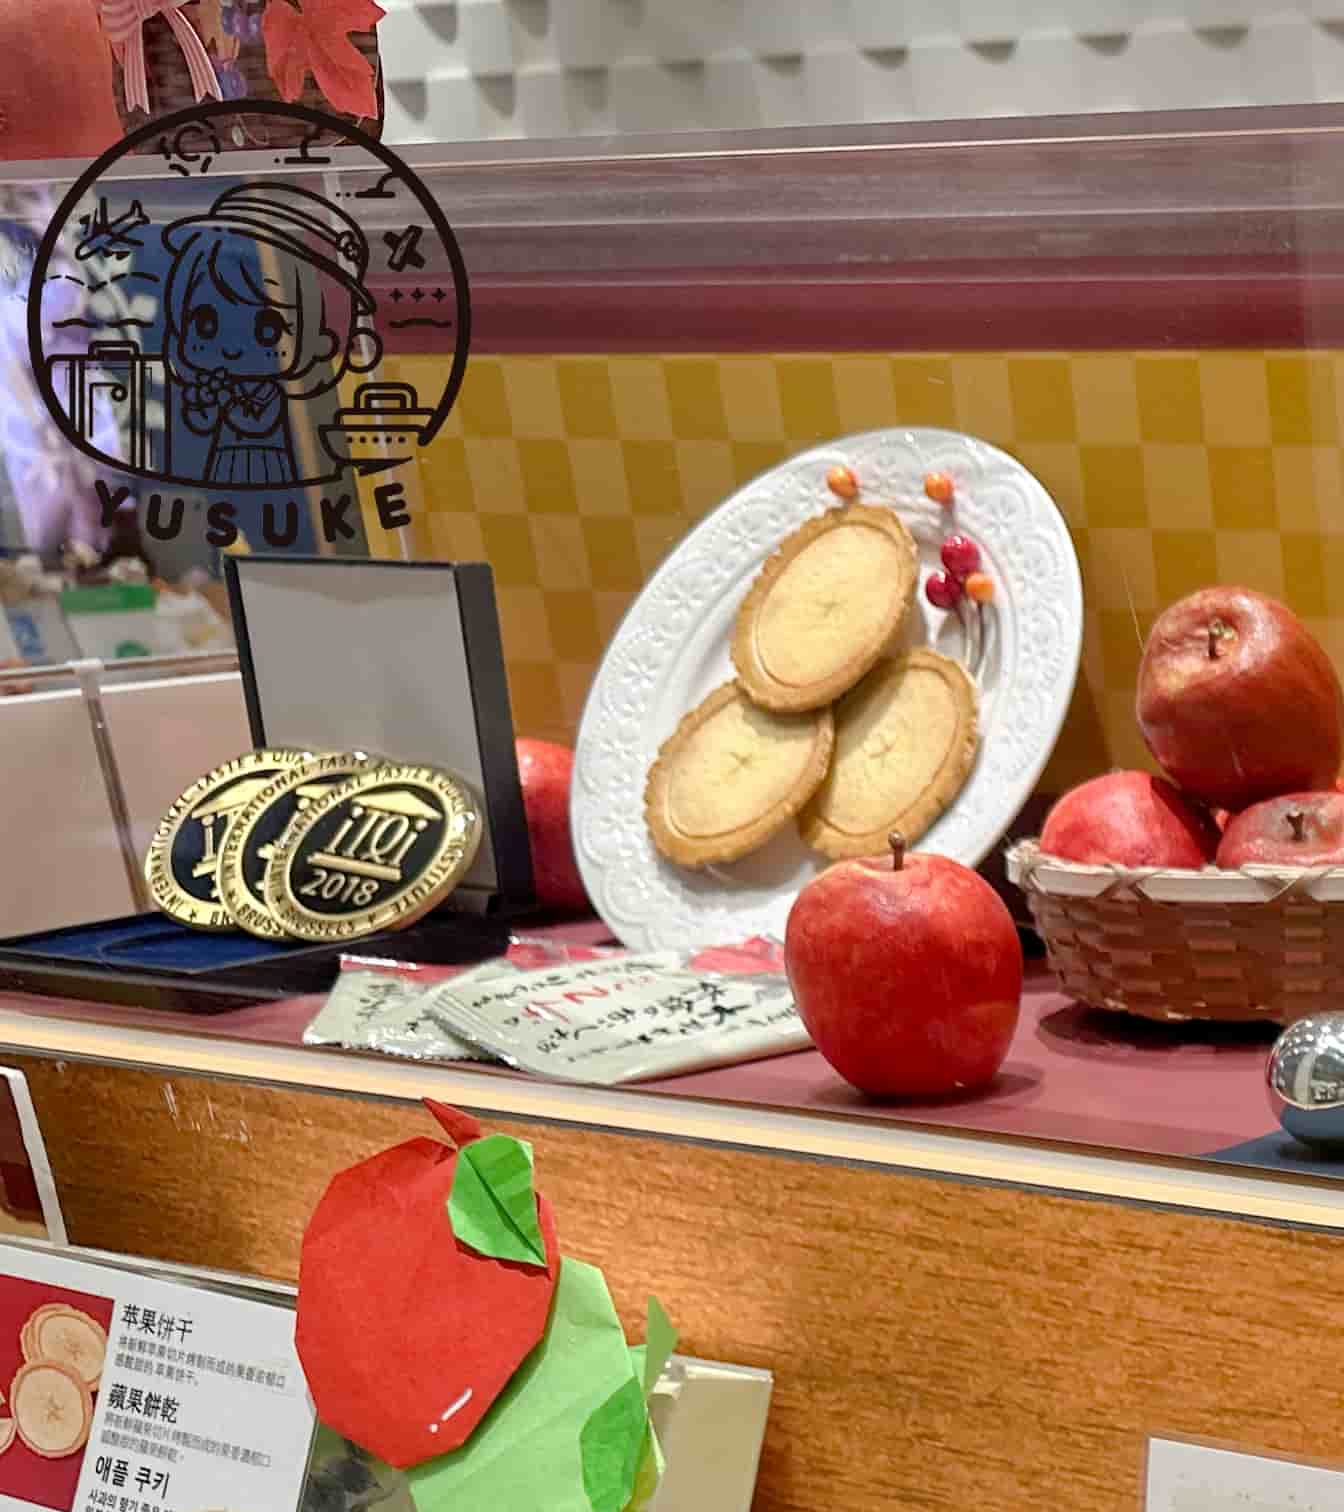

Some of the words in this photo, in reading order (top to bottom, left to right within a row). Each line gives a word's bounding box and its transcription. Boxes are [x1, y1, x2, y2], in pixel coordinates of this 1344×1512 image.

[301, 869, 379, 907] 2018
[121, 1303, 194, 1344] 苹果饼干
[107, 1383, 181, 1425] 蘋果餅乾
[94, 1454, 130, 1488] 애플
[134, 1466, 170, 1500] 쿠키
[87, 1487, 116, 1511] 사과의
